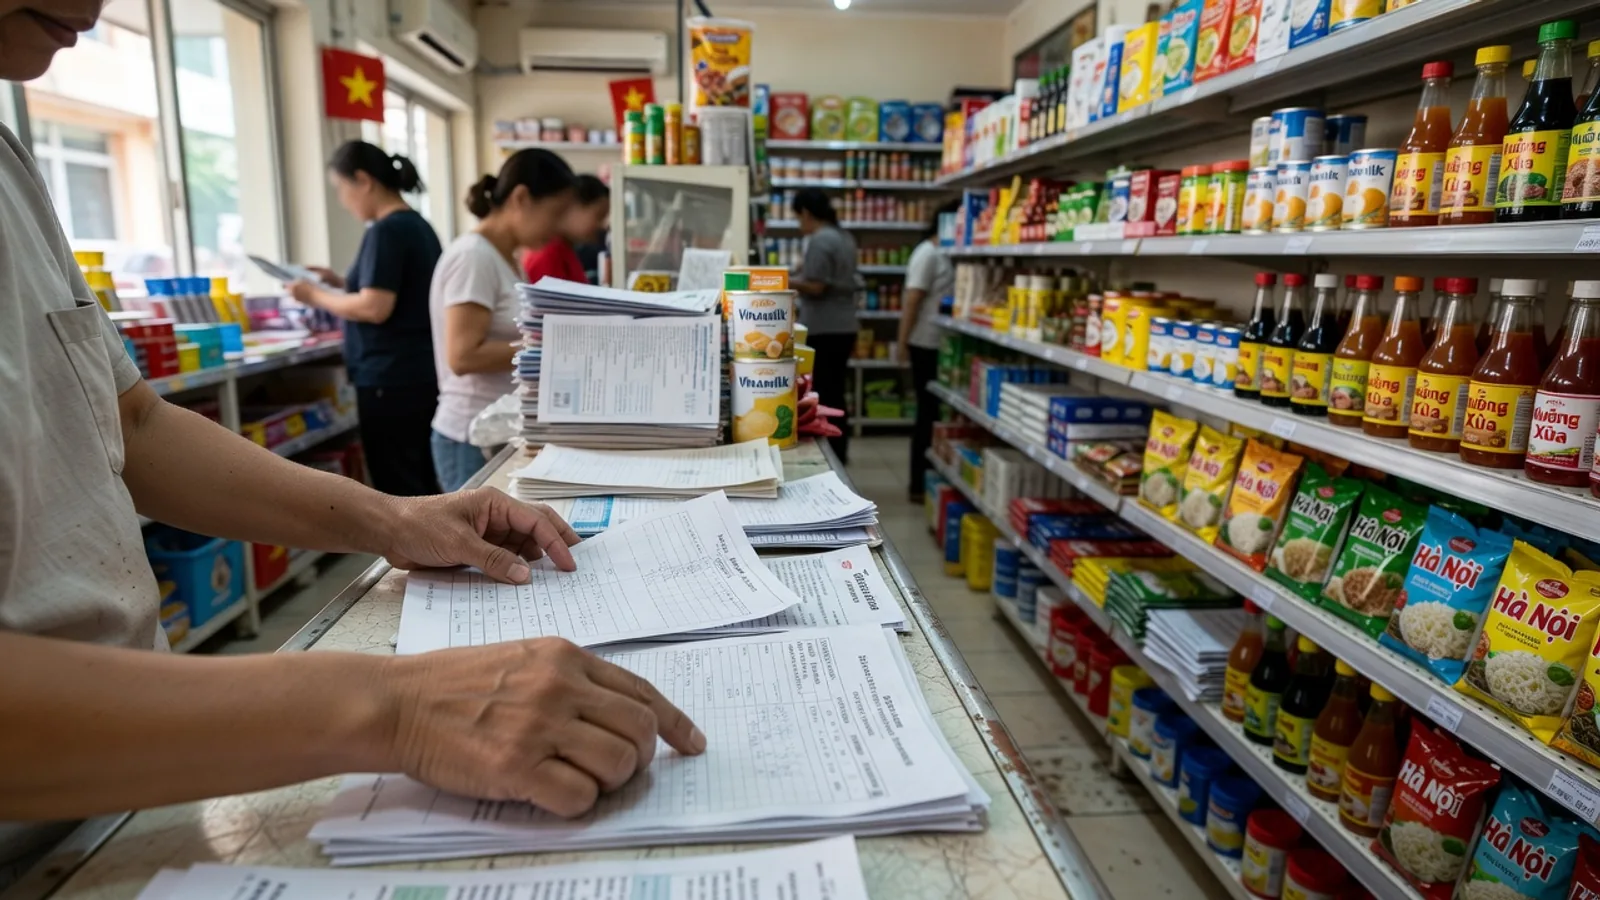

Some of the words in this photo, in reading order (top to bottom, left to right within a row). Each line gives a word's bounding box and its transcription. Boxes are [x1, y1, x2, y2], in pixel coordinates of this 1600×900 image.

[1412, 543, 1442, 573] Hà
[1440, 555, 1484, 591] Nội
[1492, 585, 1529, 622] Hà
[1527, 602, 1581, 644] Nội
[1398, 758, 1426, 794] Hà
[1421, 777, 1466, 819] Nội
[1482, 815, 1512, 853] Hà
[1507, 836, 1557, 882] Nội
